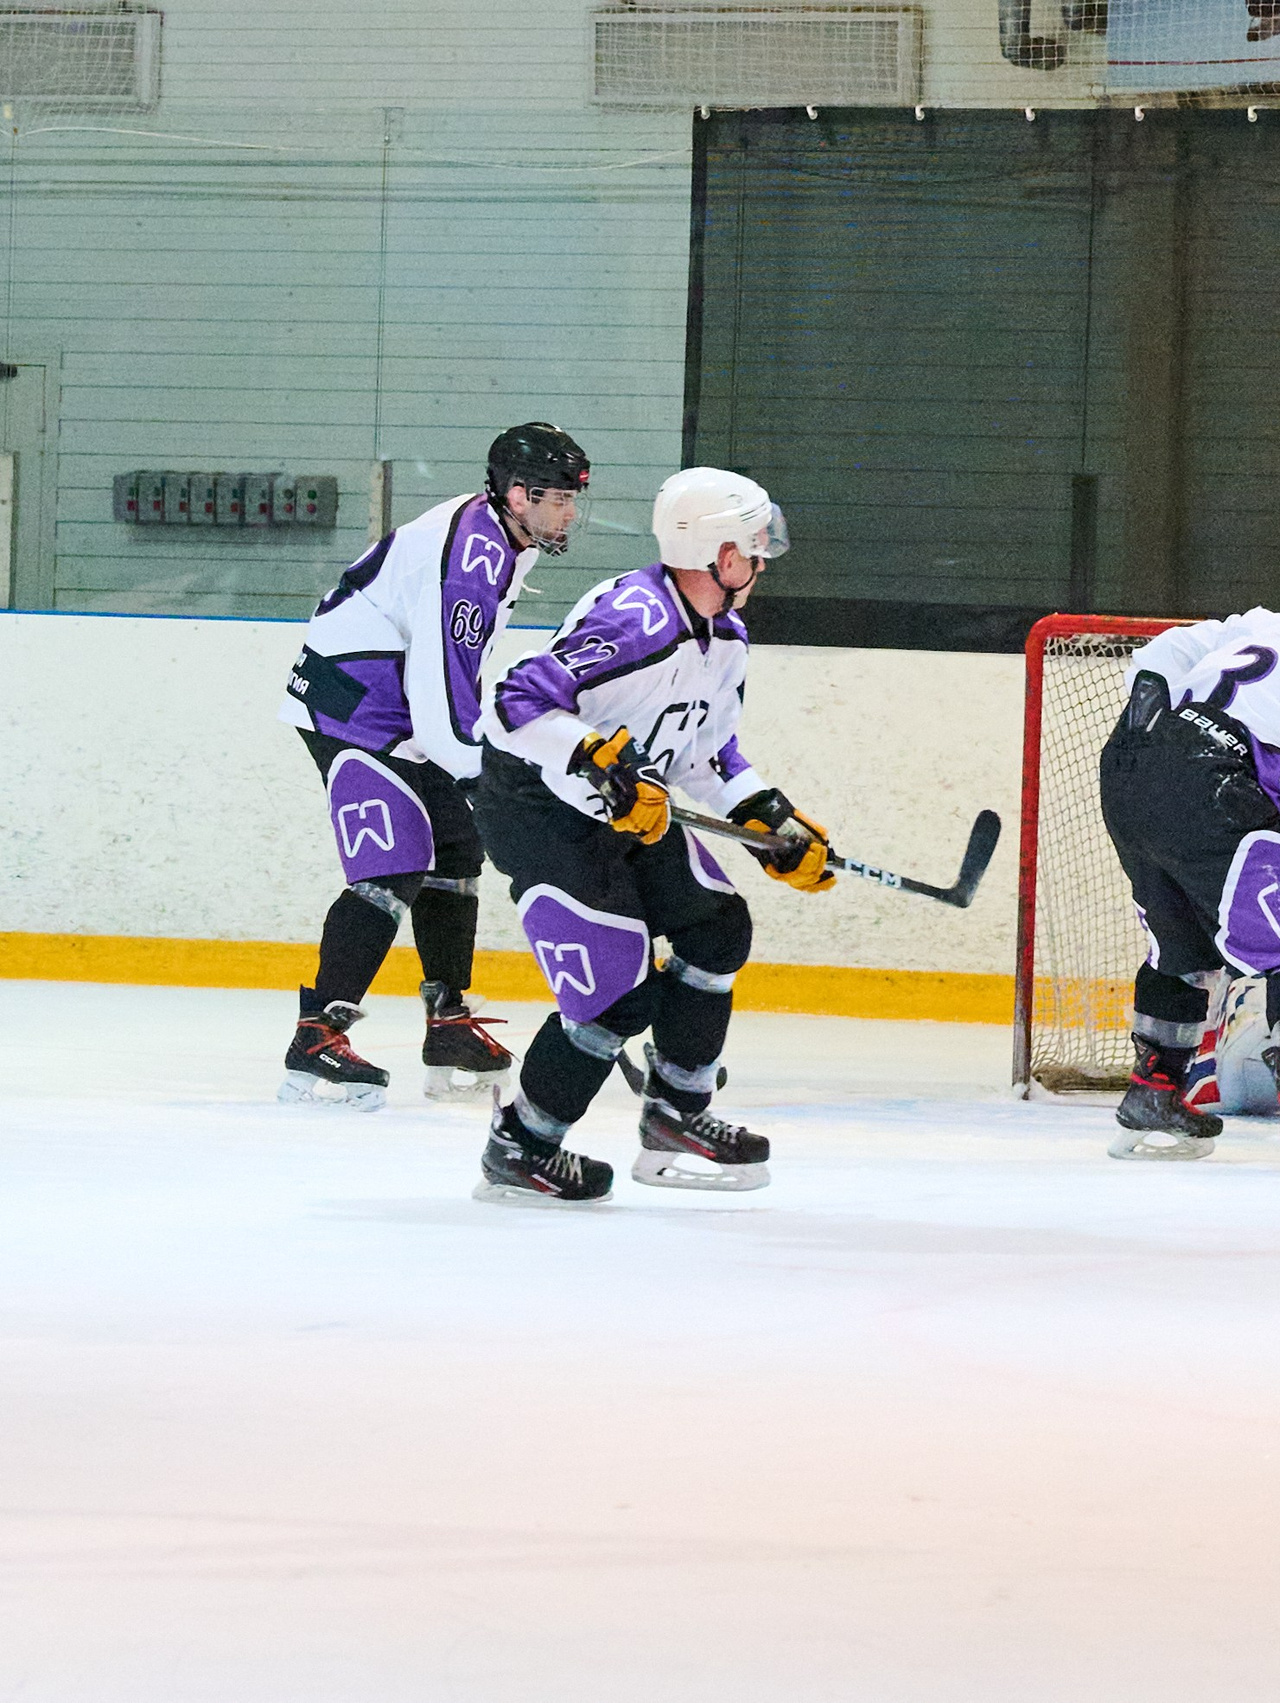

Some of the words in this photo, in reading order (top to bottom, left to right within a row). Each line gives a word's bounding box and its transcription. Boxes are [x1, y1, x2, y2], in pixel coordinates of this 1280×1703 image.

[450, 598, 485, 649] 69
[550, 635, 620, 682] 22
[844, 857, 902, 889] CCM
